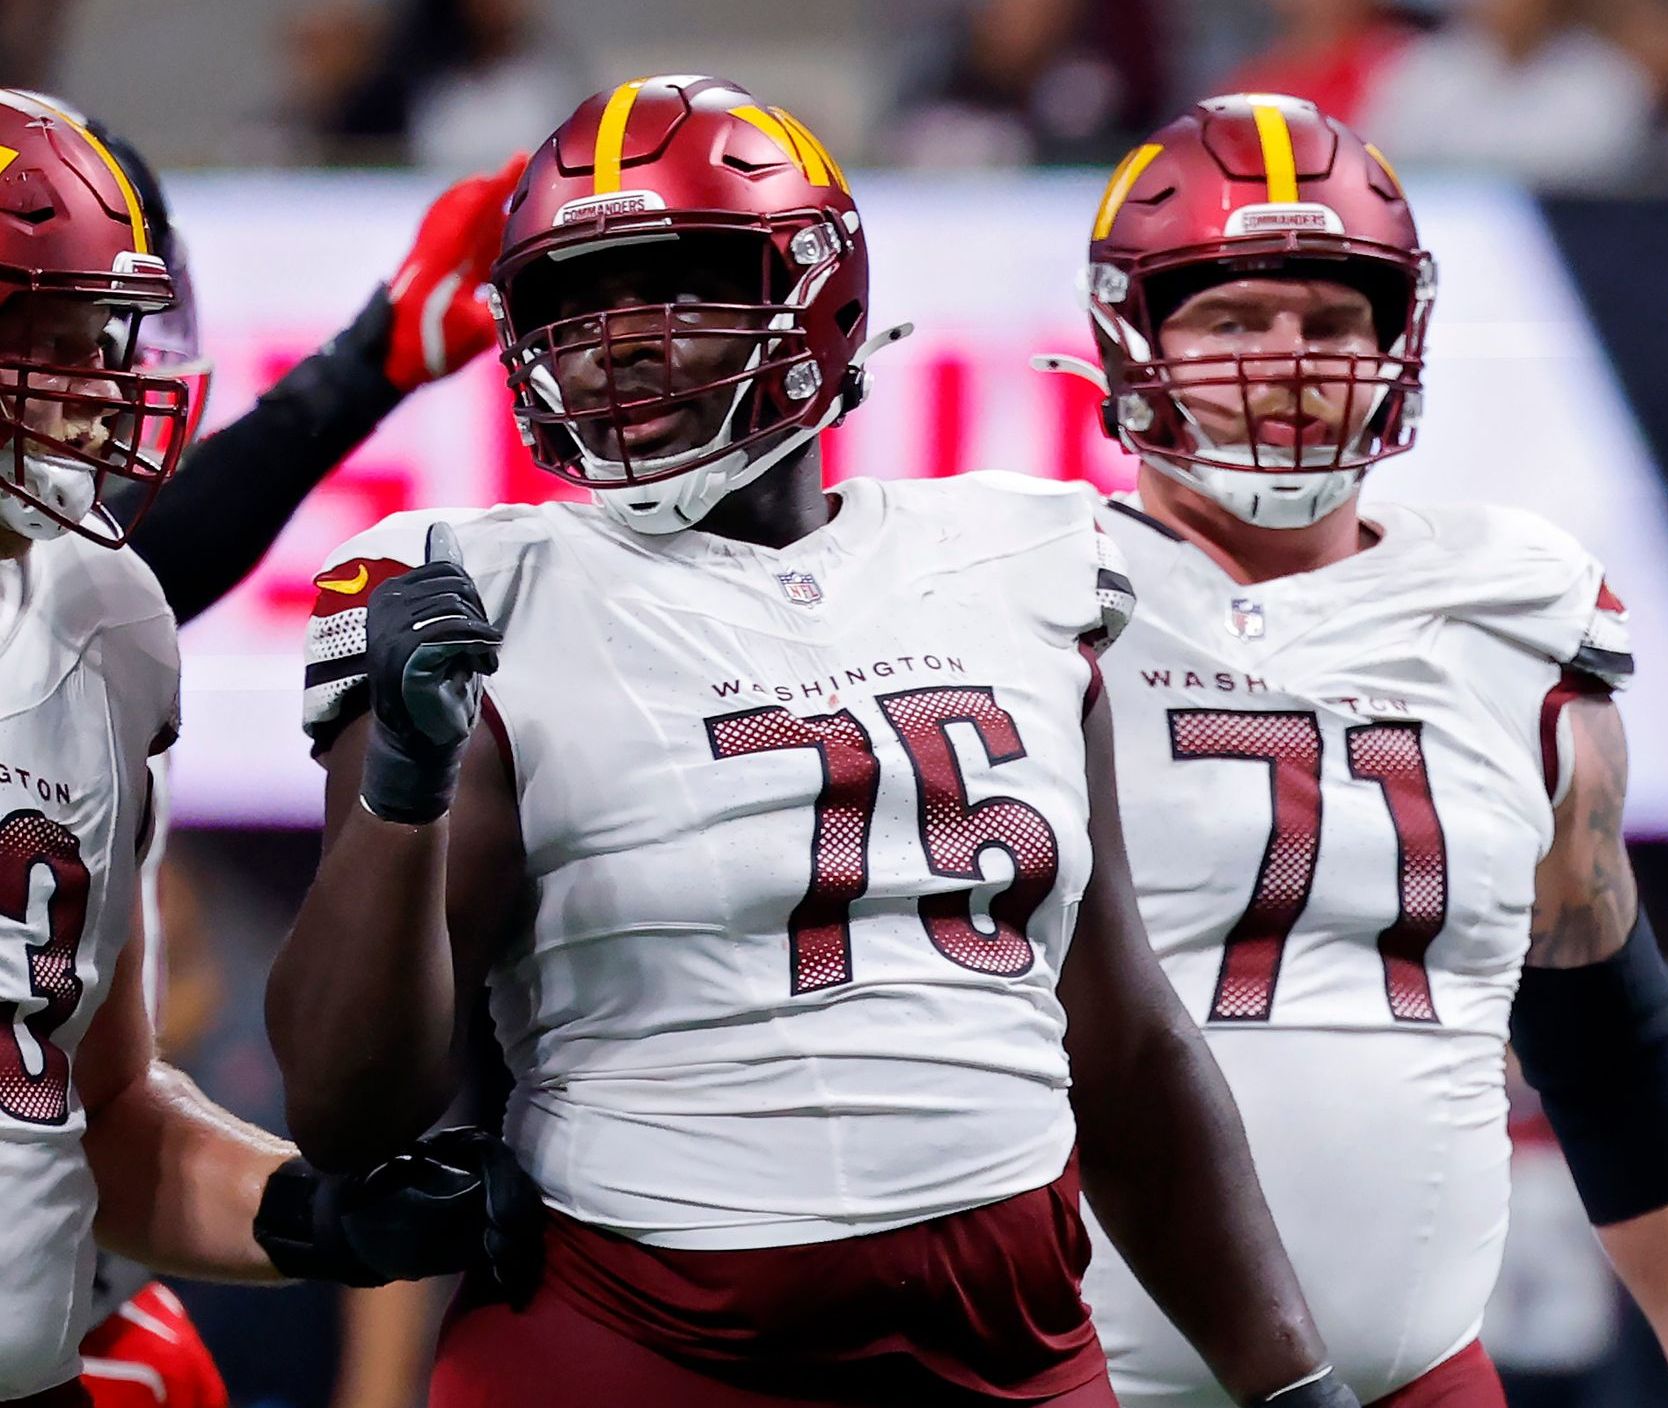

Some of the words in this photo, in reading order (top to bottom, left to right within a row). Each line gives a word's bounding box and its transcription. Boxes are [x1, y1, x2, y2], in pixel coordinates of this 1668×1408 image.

[712, 655, 965, 702] WASHINGTON
[703, 685, 1058, 997] 75
[1166, 708, 1449, 1025] 71
